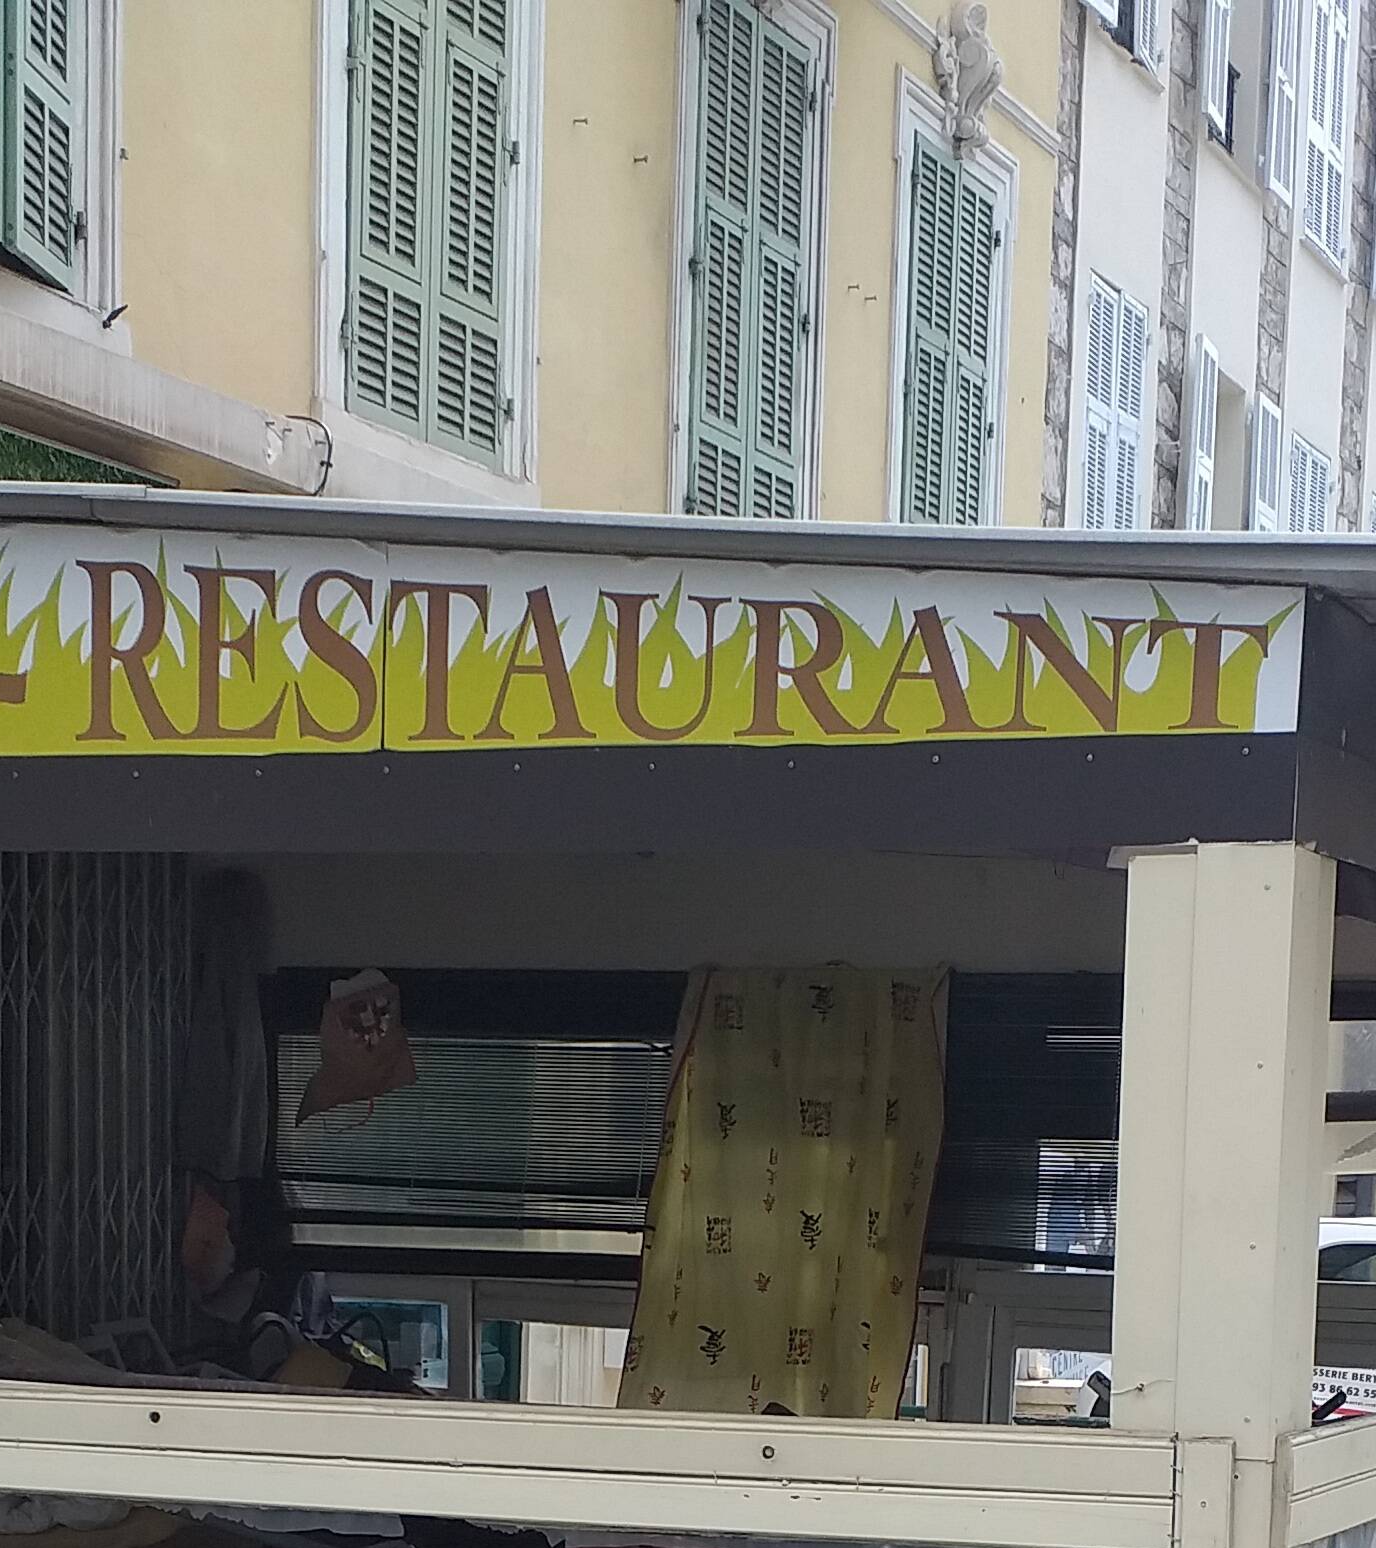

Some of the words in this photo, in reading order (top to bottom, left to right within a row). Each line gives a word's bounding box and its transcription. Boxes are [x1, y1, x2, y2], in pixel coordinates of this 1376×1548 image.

[75, 559, 1270, 743] RESTAURANT
[1346, 1386, 1360, 1397] 62
[1363, 1388, 1376, 1399] 55
